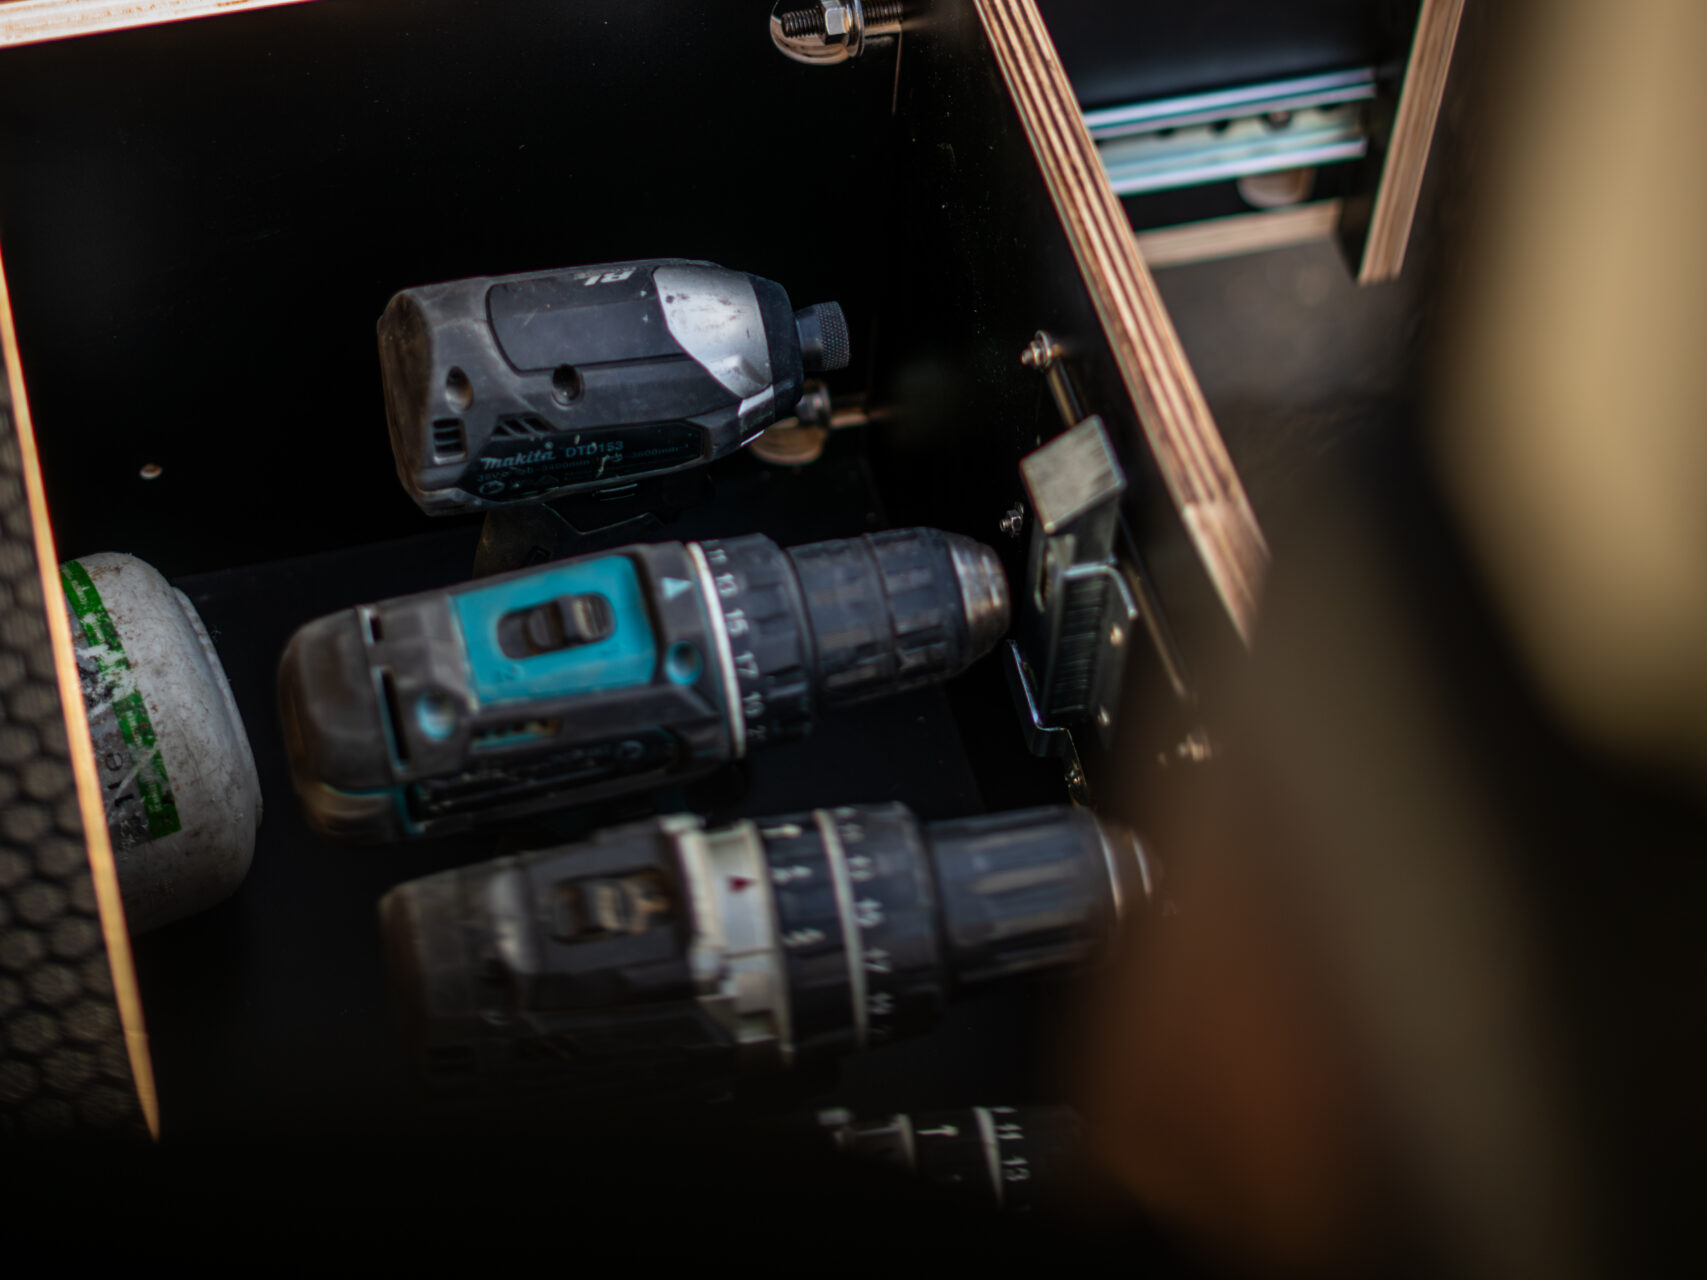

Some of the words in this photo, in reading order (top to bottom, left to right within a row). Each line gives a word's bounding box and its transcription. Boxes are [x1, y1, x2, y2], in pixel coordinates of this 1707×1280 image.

[480, 448, 556, 471] makita
[565, 440, 624, 459] DTD153
[715, 572, 739, 599] 13
[724, 608, 750, 638] 15
[734, 650, 760, 680] 17
[742, 691, 766, 718] 19
